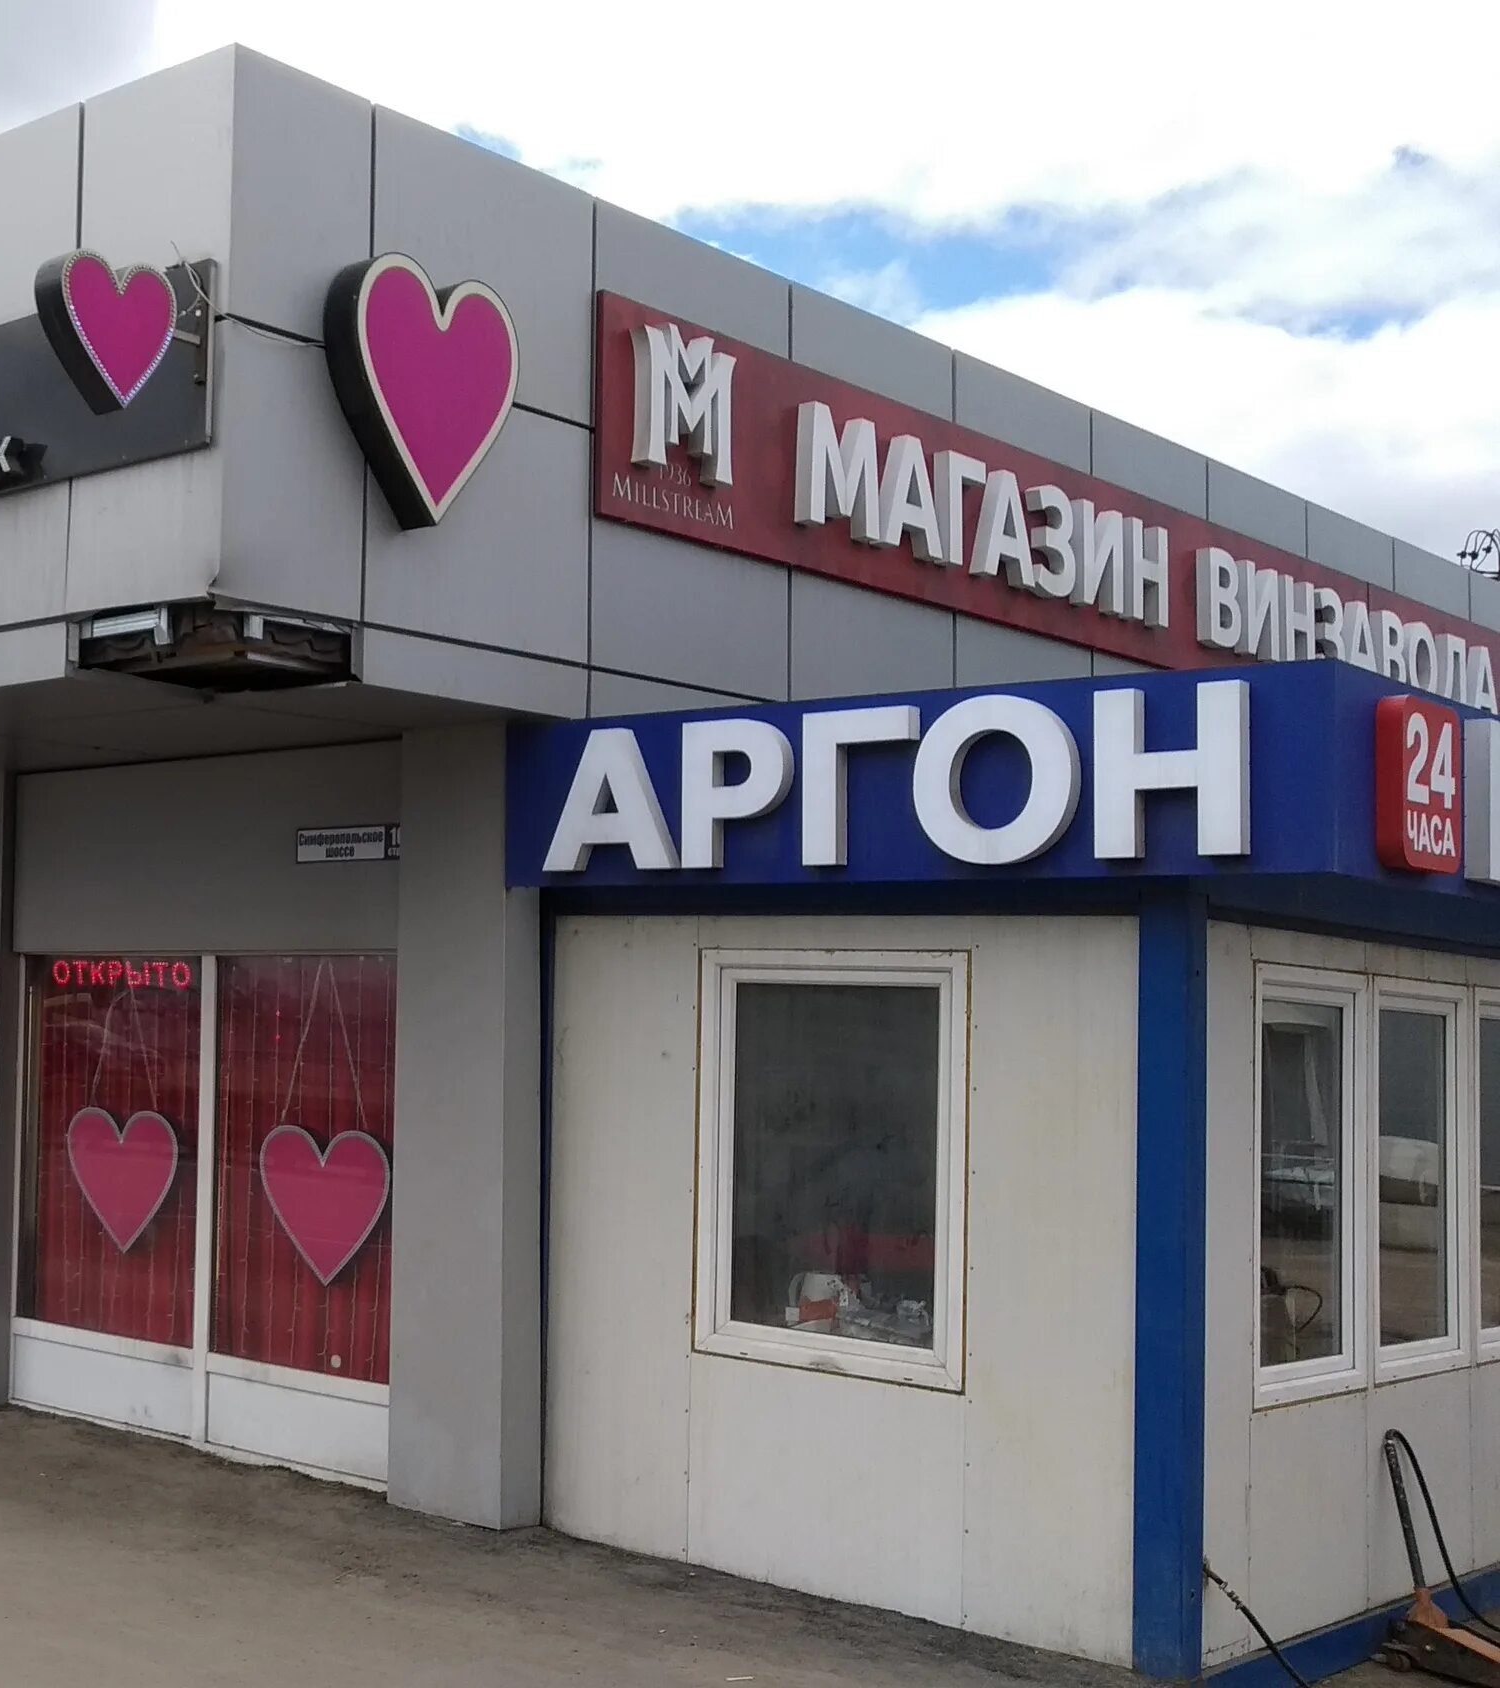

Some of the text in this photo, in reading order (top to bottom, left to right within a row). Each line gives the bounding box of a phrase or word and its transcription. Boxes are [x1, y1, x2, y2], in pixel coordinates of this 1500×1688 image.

[612, 472, 735, 531] MILLSTREAM
[794, 401, 1169, 628] МАГАЗИН
[542, 678, 1251, 873] АРГОН
[1406, 711, 1456, 810] 24
[325, 846, 355, 858] шоссе
[1406, 809, 1456, 858] ЧАСА
[52, 960, 192, 988] ОТКРЫТО
